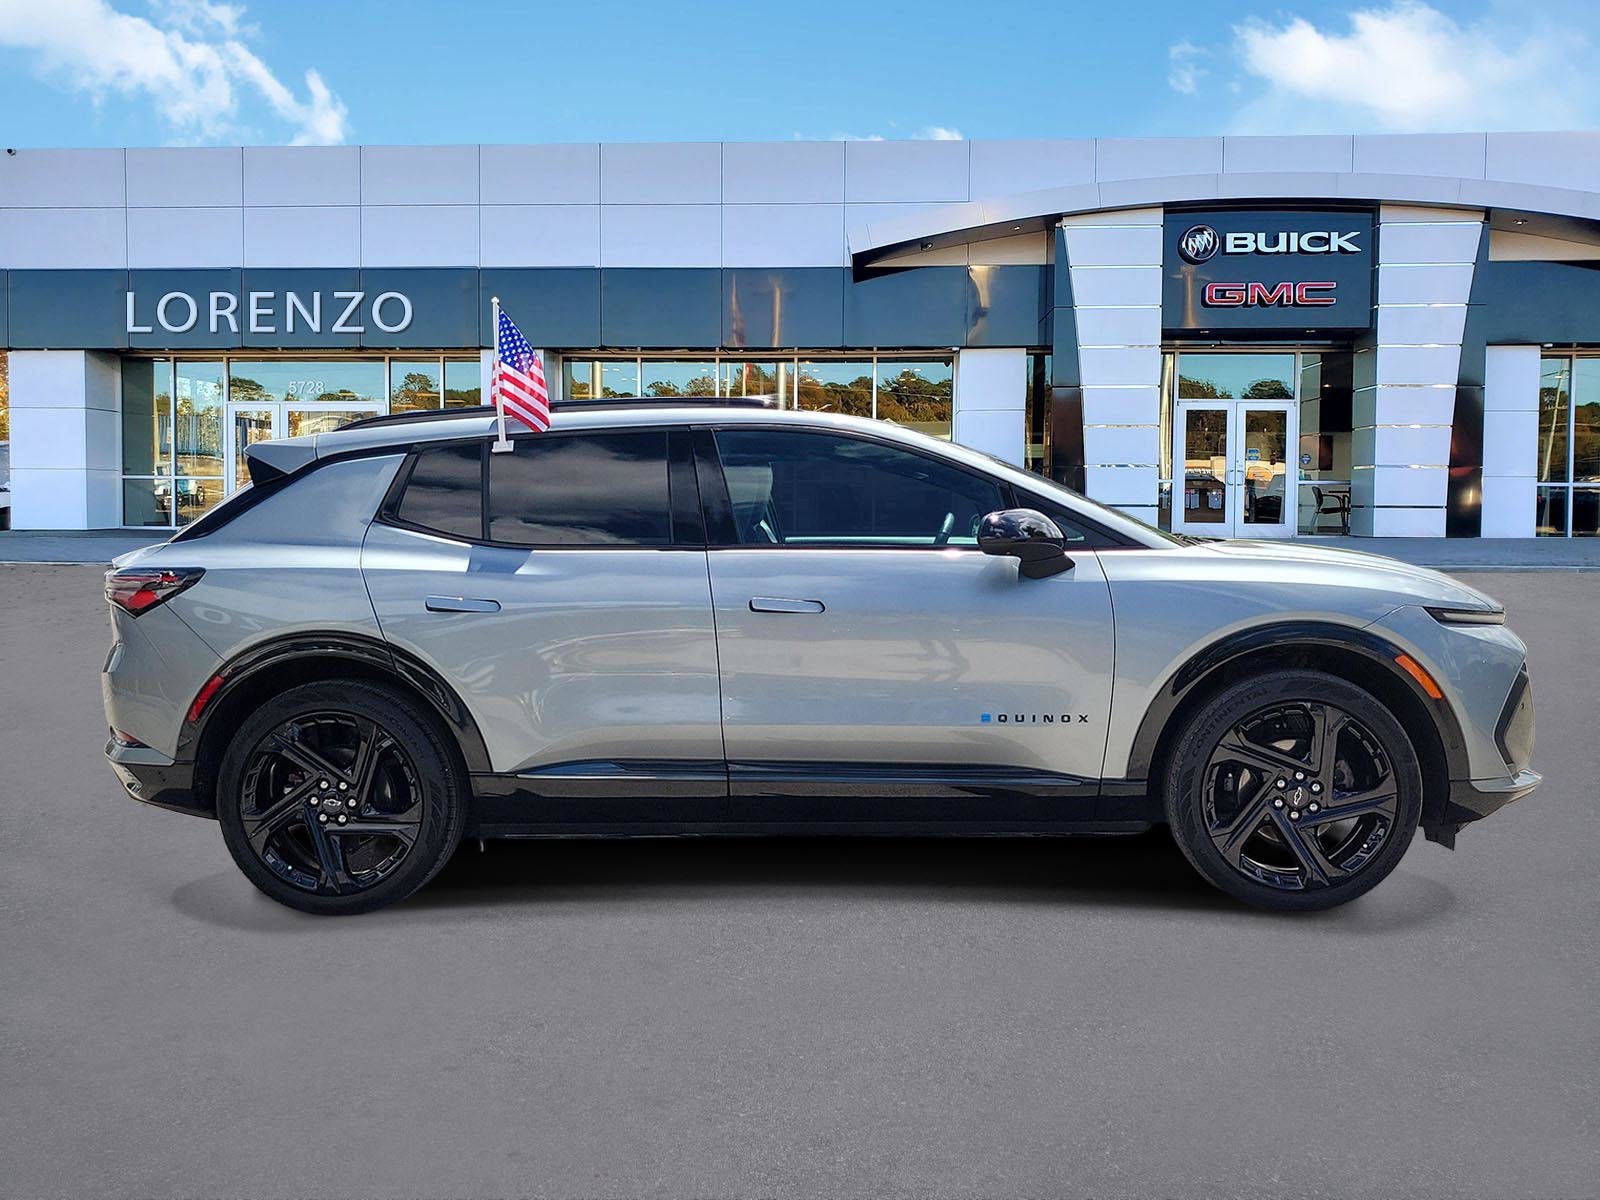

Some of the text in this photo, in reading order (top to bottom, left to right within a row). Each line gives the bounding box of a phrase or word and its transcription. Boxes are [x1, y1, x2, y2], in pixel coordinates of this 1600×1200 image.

[1225, 231, 1362, 254] BUICK
[1205, 281, 1337, 306] GMC
[126, 291, 414, 334] LORENZO
[288, 381, 325, 394] 5728
